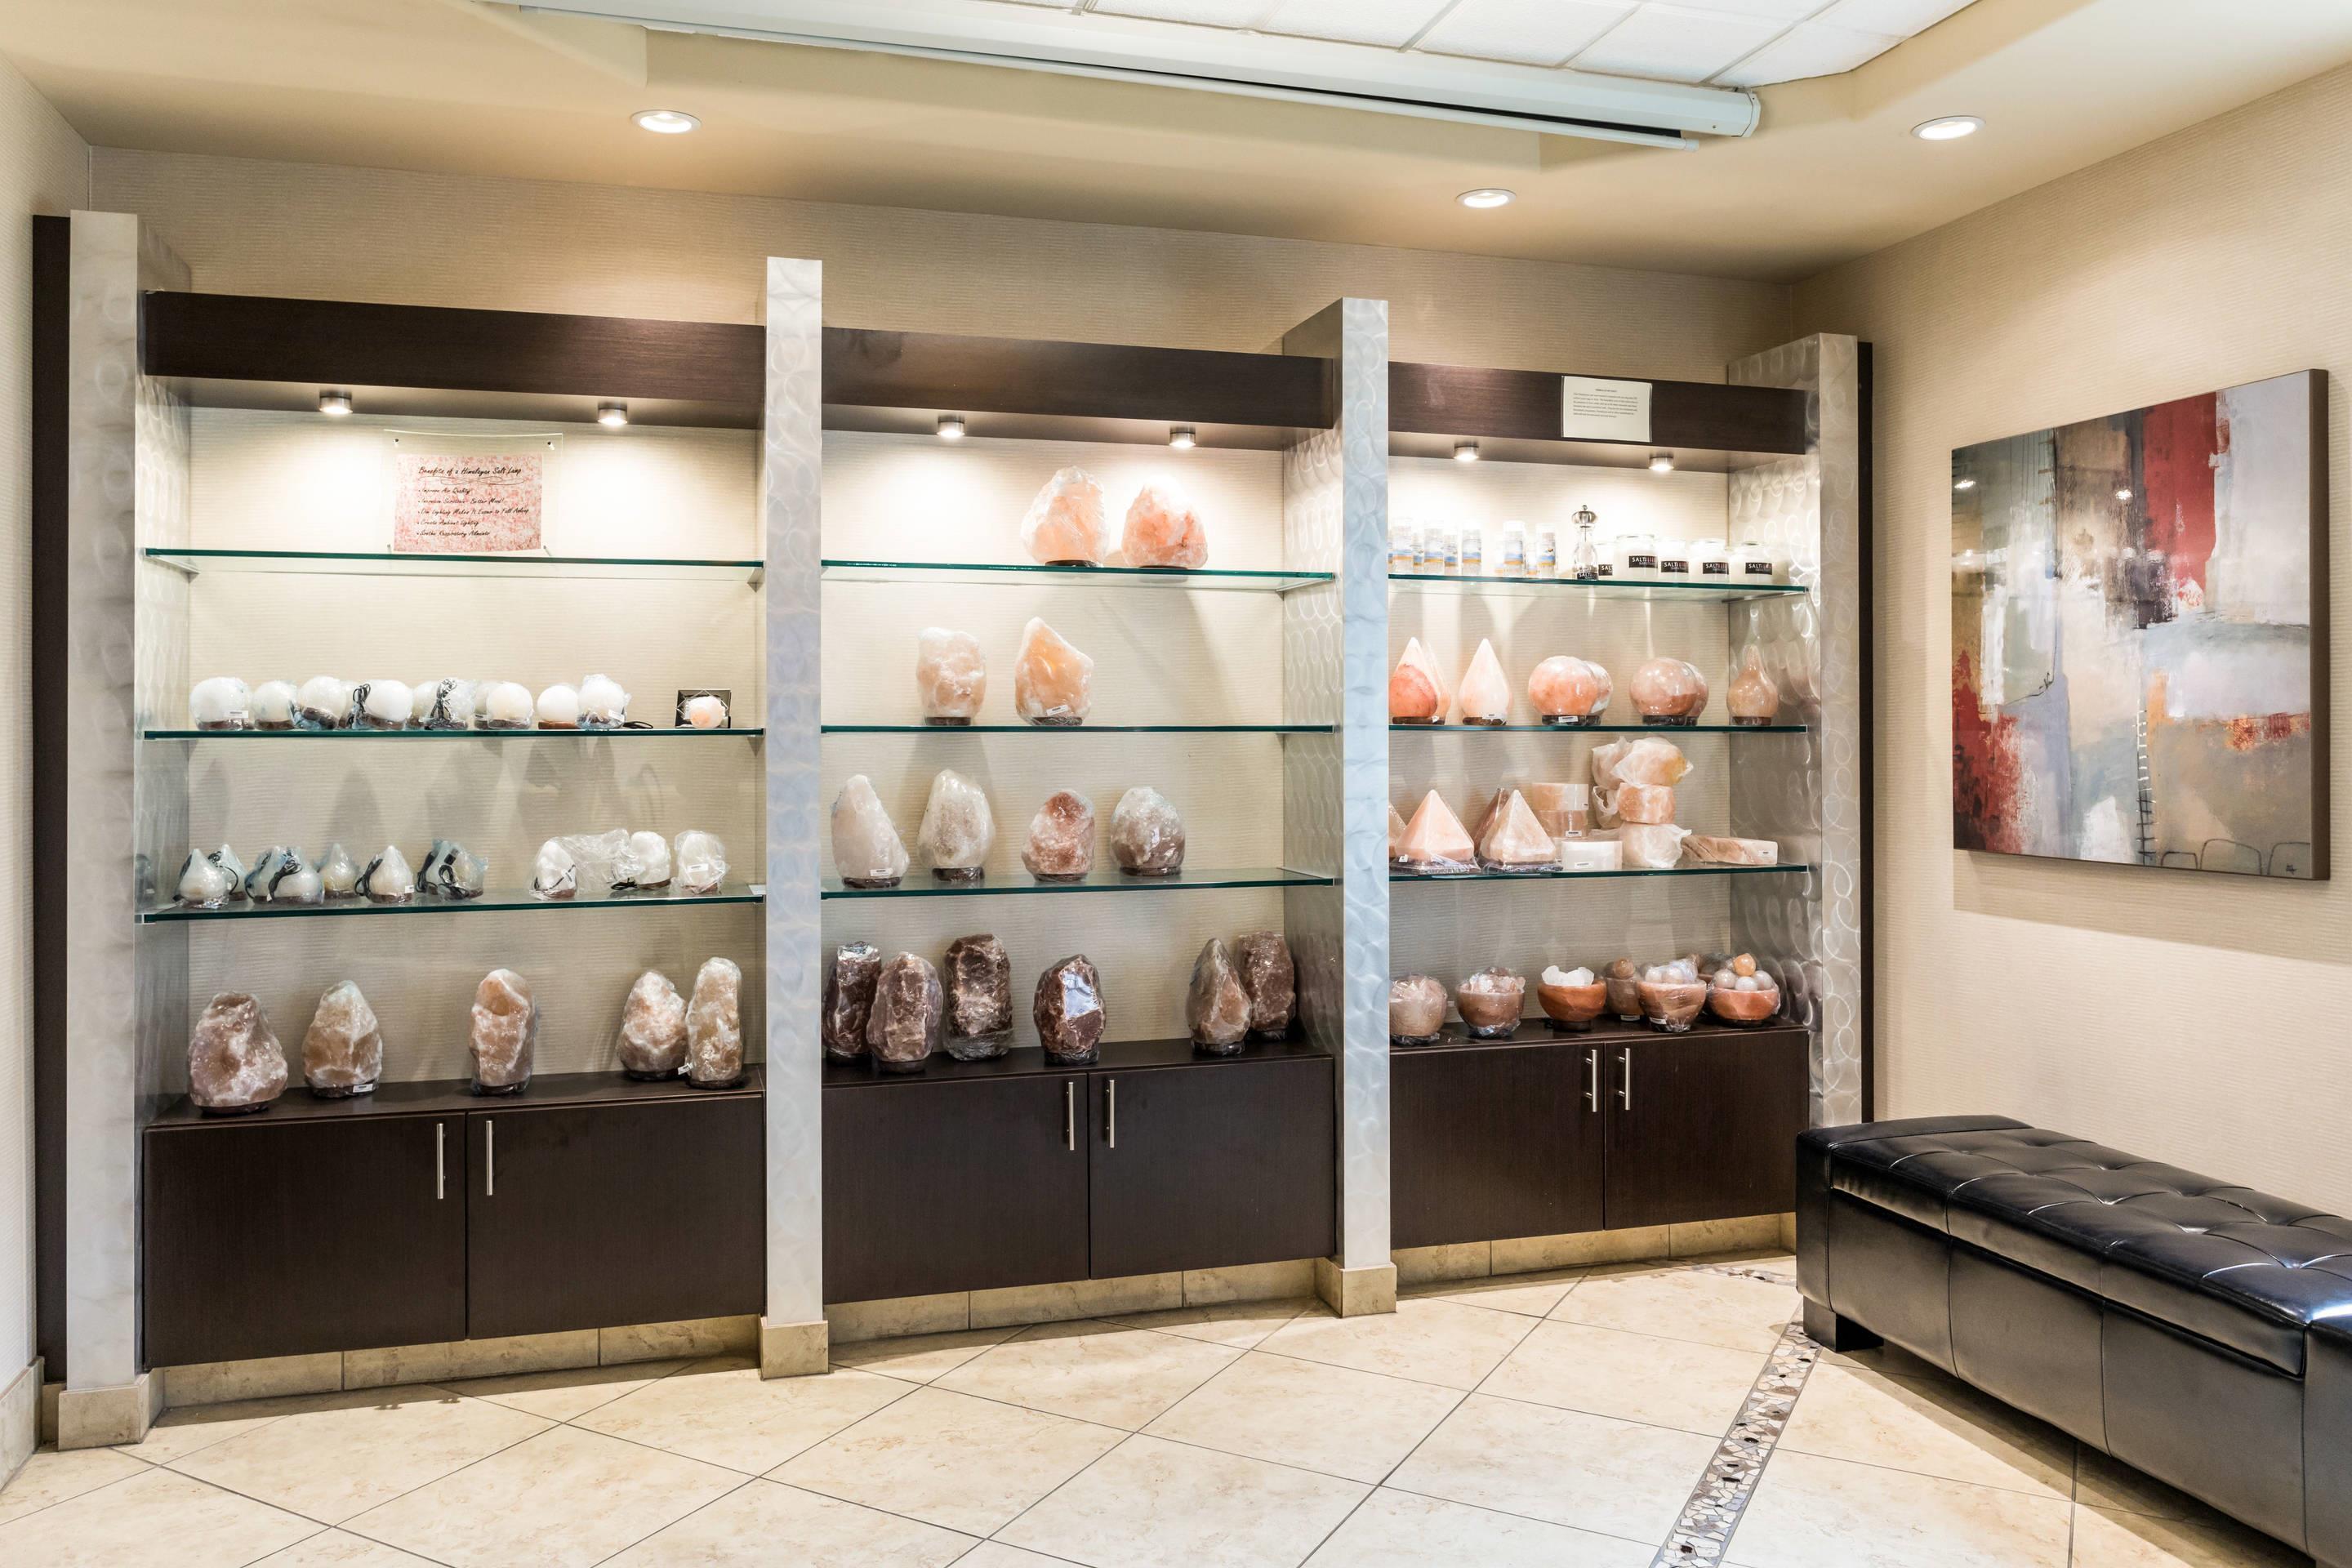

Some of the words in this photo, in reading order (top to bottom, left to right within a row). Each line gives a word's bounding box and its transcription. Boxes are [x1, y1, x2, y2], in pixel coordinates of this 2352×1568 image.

[447, 468, 453, 476] of
[461, 466, 490, 476] Himalayan
[492, 466, 506, 474] Salt
[506, 466, 522, 476] Lamp
